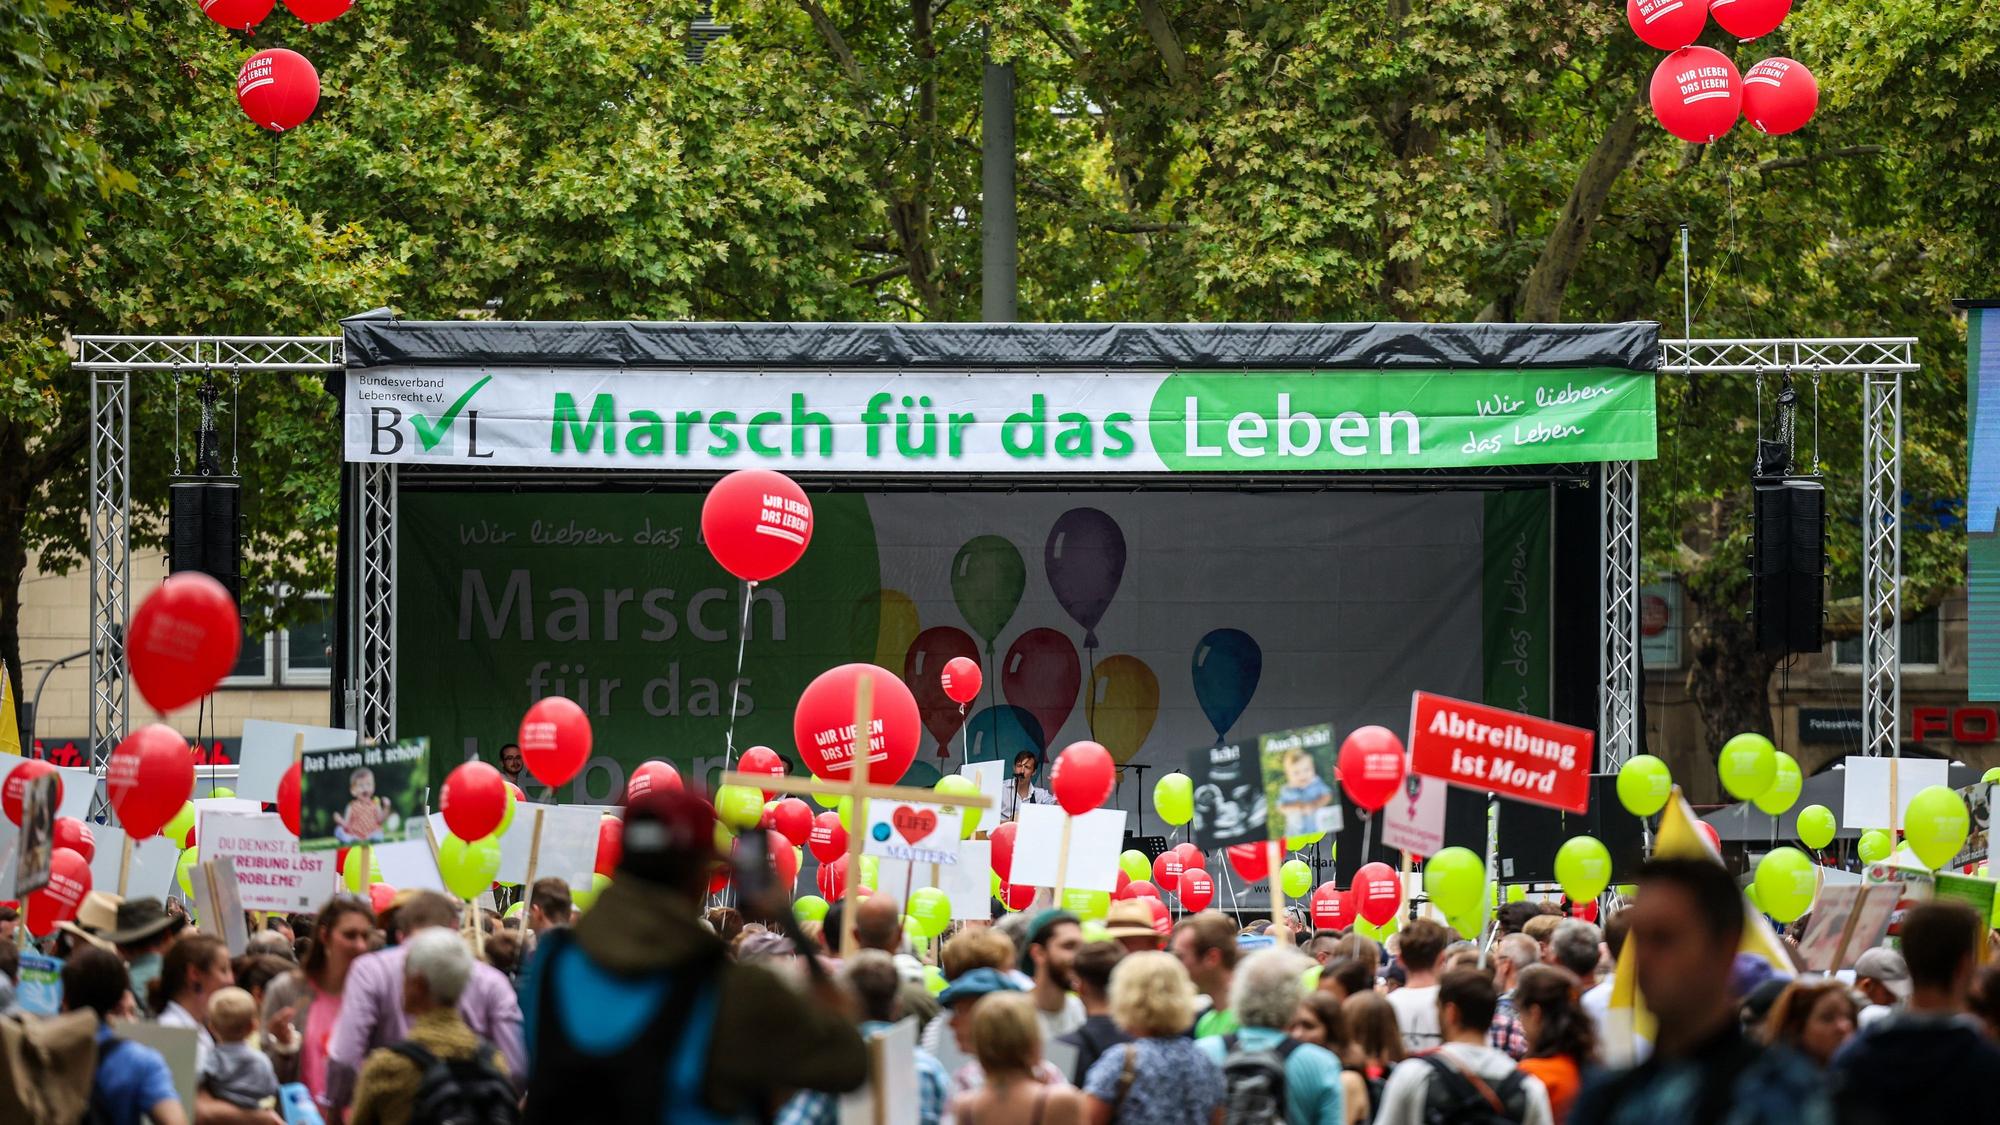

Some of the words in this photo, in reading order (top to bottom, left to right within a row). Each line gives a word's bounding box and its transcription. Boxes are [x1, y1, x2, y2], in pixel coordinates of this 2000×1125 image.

[247, 57, 273, 71] LIEBEN
[247, 66, 273, 81] LEBEN!
[1676, 69, 1697, 84] WIR
[1698, 66, 1728, 79] LIEBEN
[1759, 67, 1785, 80] LEBEN!
[1680, 81, 1700, 96] DAS
[1701, 78, 1730, 90] LEBEN!
[359, 375, 445, 388] Bundesverband
[358, 390, 424, 403] Lebensrecht
[426, 393, 446, 404] e.V.
[1476, 394, 1526, 418] Wir
[1535, 382, 1616, 409] lieben
[550, 391, 833, 457] Marsch
[860, 391, 976, 459] für
[1000, 392, 1135, 459] das
[1184, 392, 1421, 458] Leben
[1459, 431, 1504, 455] das
[1514, 421, 1587, 447] Leben
[762, 493, 783, 510] WIR
[784, 497, 809, 519] LIEBEN
[760, 508, 782, 525] DAS
[782, 513, 809, 533] LEBEN!
[458, 521, 517, 546] Wir
[529, 521, 624, 546] lieben
[633, 518, 684, 550] das
[1503, 531, 1529, 615] Leben
[457, 565, 788, 642] Marsch
[1501, 626, 1533, 677] das
[525, 660, 622, 717] für
[641, 662, 756, 718] das
[814, 729, 839, 747] WIR
[839, 718, 884, 742] LIEEN
[1266, 736, 1302, 752] Auch
[1428, 708, 1578, 771] Abtreibung
[303, 754, 325, 773] Das
[364, 747, 382, 766] ist
[820, 745, 844, 761] DAS
[844, 735, 886, 757] LEN!
[1450, 748, 1486, 778] ist
[1488, 758, 1557, 795] Mord
[896, 814, 932, 832] LIFE
[218, 836, 236, 850] DU
[886, 845, 959, 865] MATTERS
[292, 856, 323, 872] LÖST
